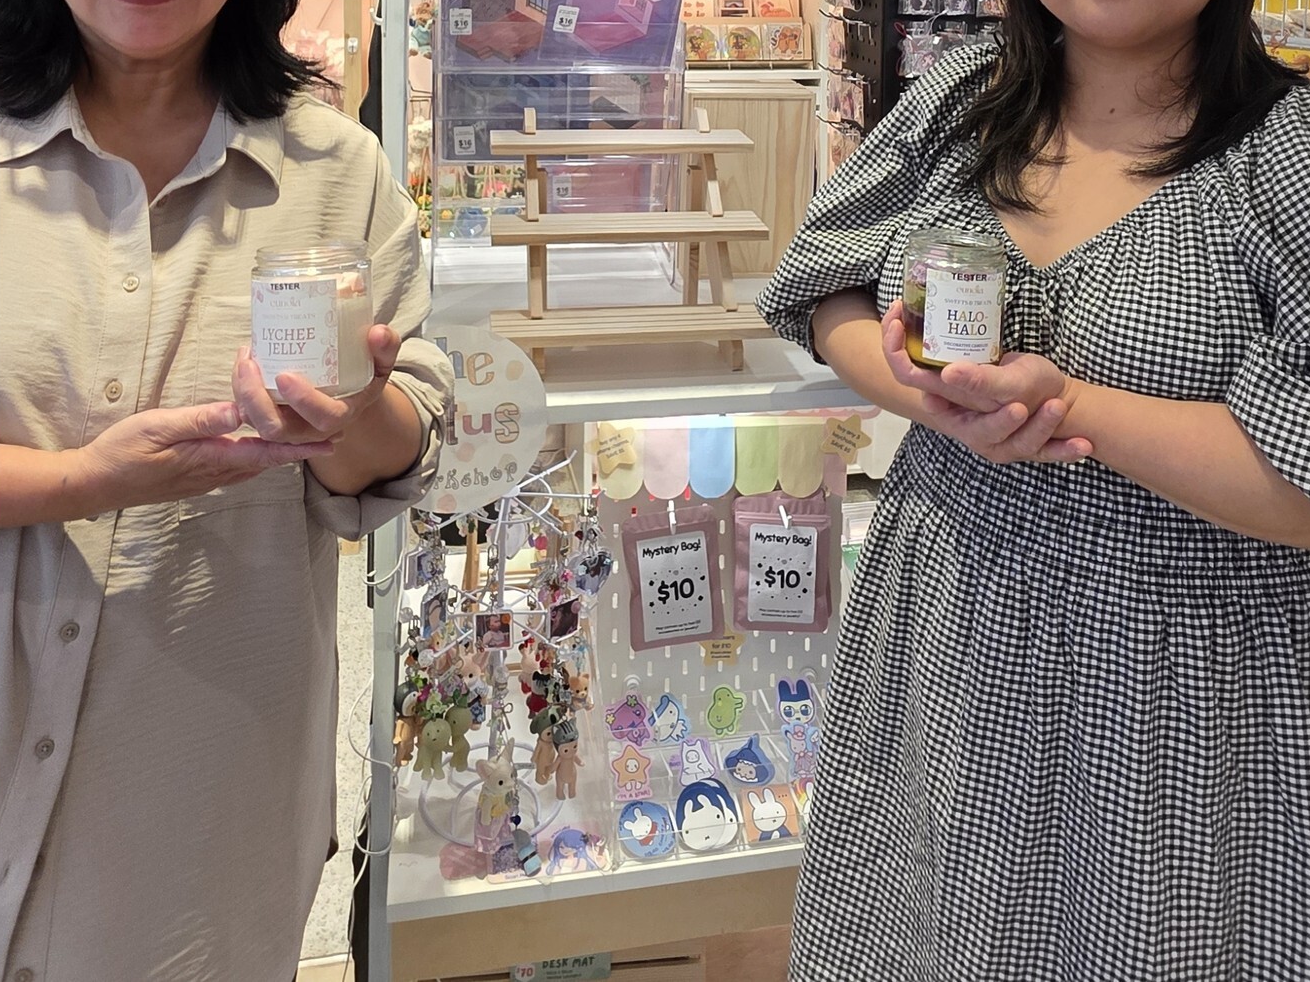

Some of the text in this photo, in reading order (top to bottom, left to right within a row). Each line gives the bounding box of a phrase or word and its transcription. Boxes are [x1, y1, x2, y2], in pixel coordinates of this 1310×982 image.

[952, 273, 987, 281] TESTER
[270, 283, 300, 291] TESTER
[947, 309, 988, 322] HALO-
[262, 327, 316, 341] LYCHEE
[948, 322, 987, 335] HALO
[268, 342, 307, 356] JELLY
[755, 533, 813, 546] Mystery Bag!
[642, 539, 701, 559] Mystery Bag!
[764, 566, 801, 588] $10
[658, 578, 695, 604] $10
[542, 955, 596, 969] DESK MAT
